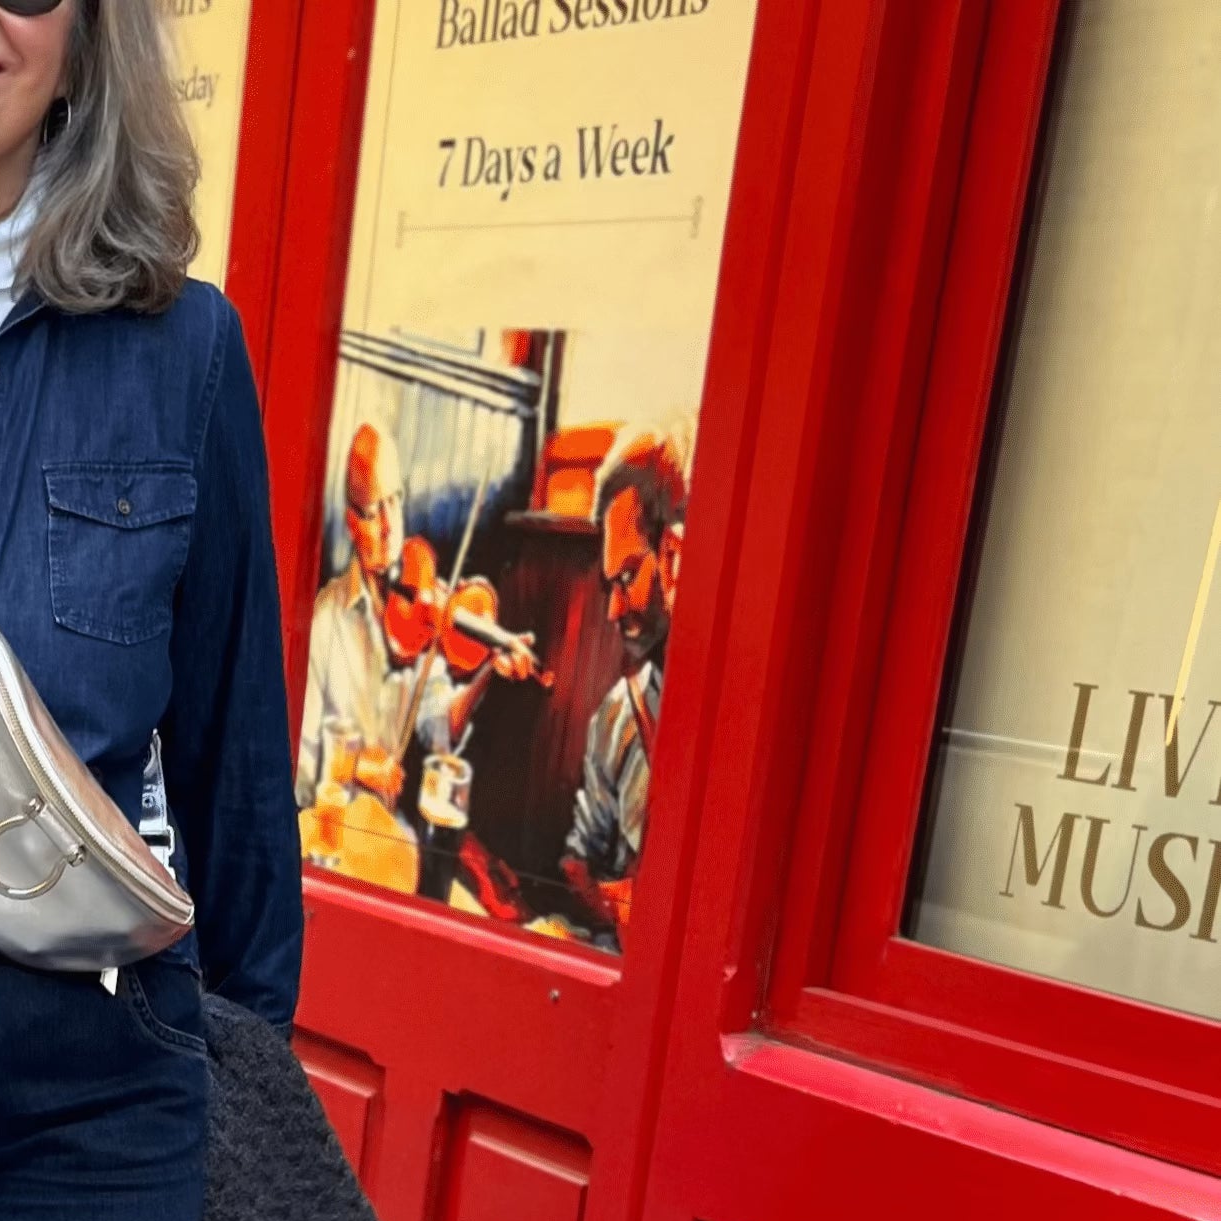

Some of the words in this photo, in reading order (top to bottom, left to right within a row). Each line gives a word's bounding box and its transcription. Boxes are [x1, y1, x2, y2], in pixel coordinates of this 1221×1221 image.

[436, 0, 539, 49] Ballad
[438, 138, 456, 188] 7
[460, 136, 537, 201] Days
[543, 143, 562, 182] a
[576, 118, 675, 179] Week
[1056, 682, 1221, 806] LIV
